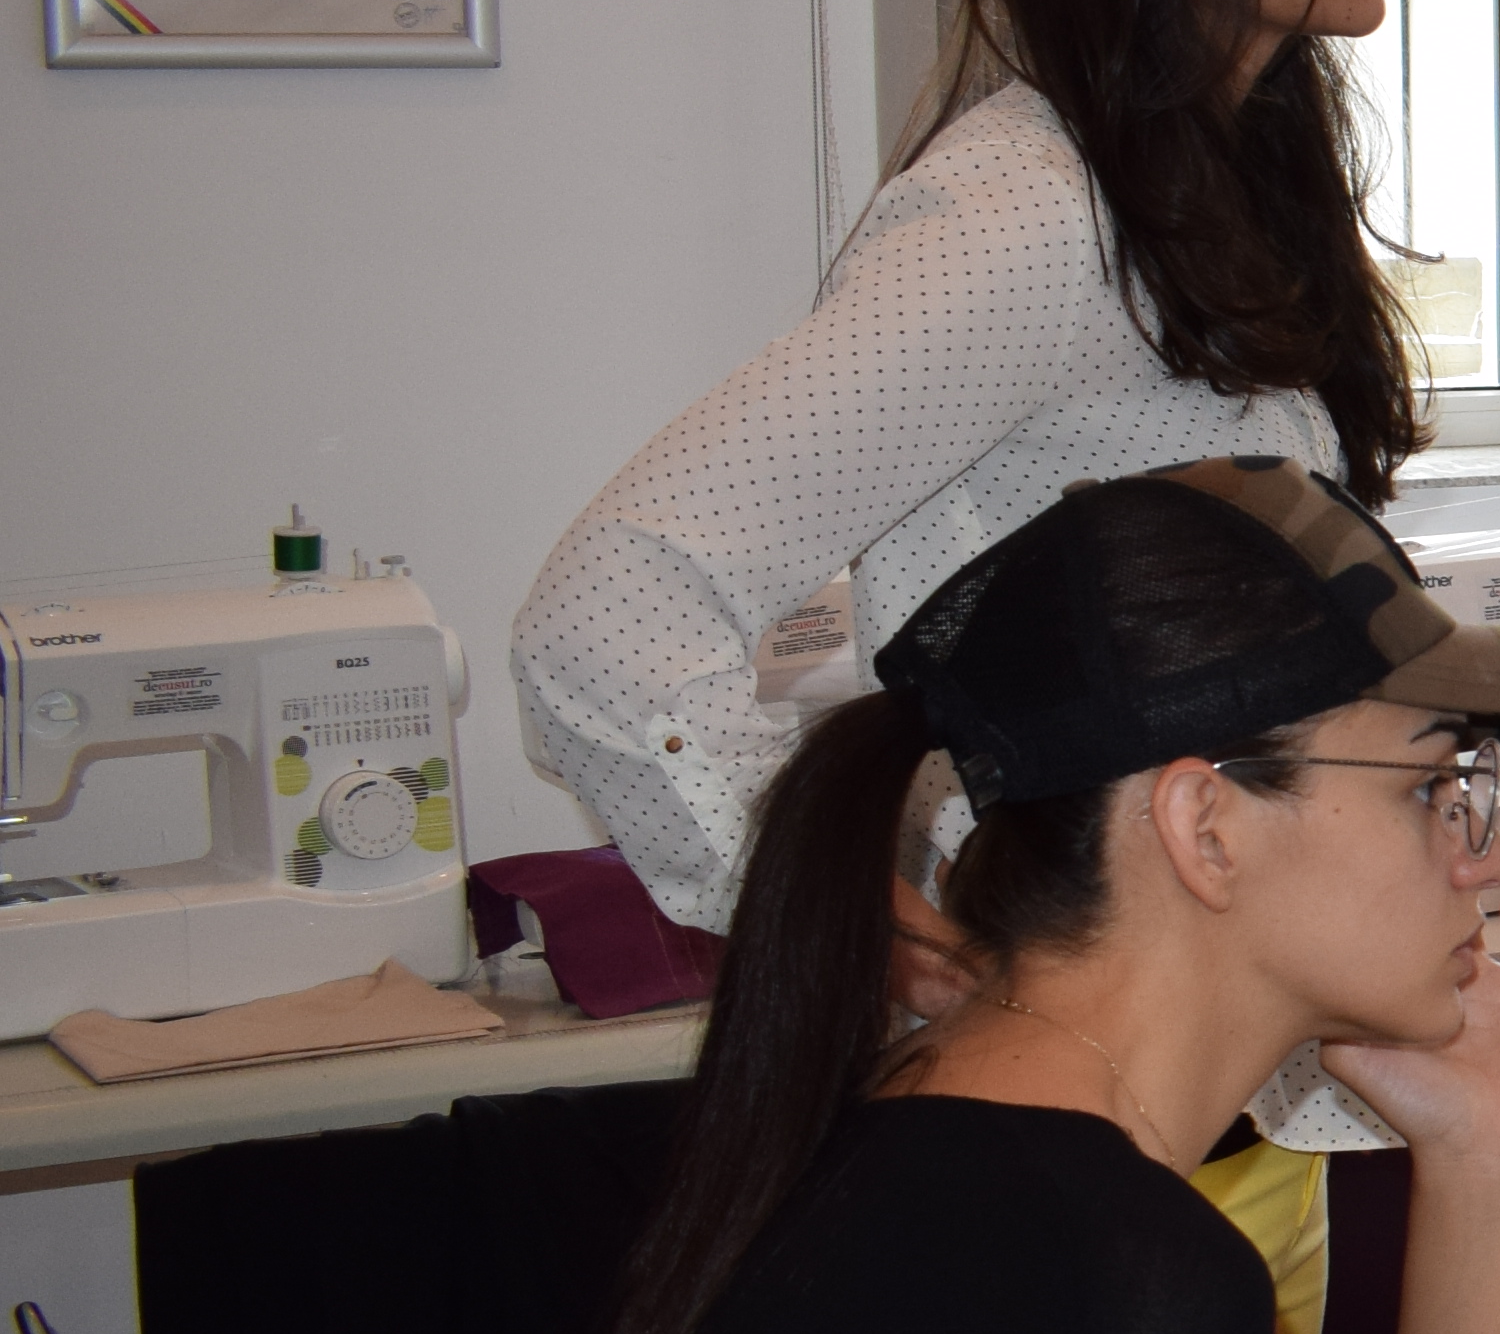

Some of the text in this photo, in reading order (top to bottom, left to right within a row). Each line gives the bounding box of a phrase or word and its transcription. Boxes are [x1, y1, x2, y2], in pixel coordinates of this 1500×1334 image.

[29, 633, 101, 648] brother
[336, 657, 370, 669] BQ25
[143, 679, 212, 692] decusut.ro
